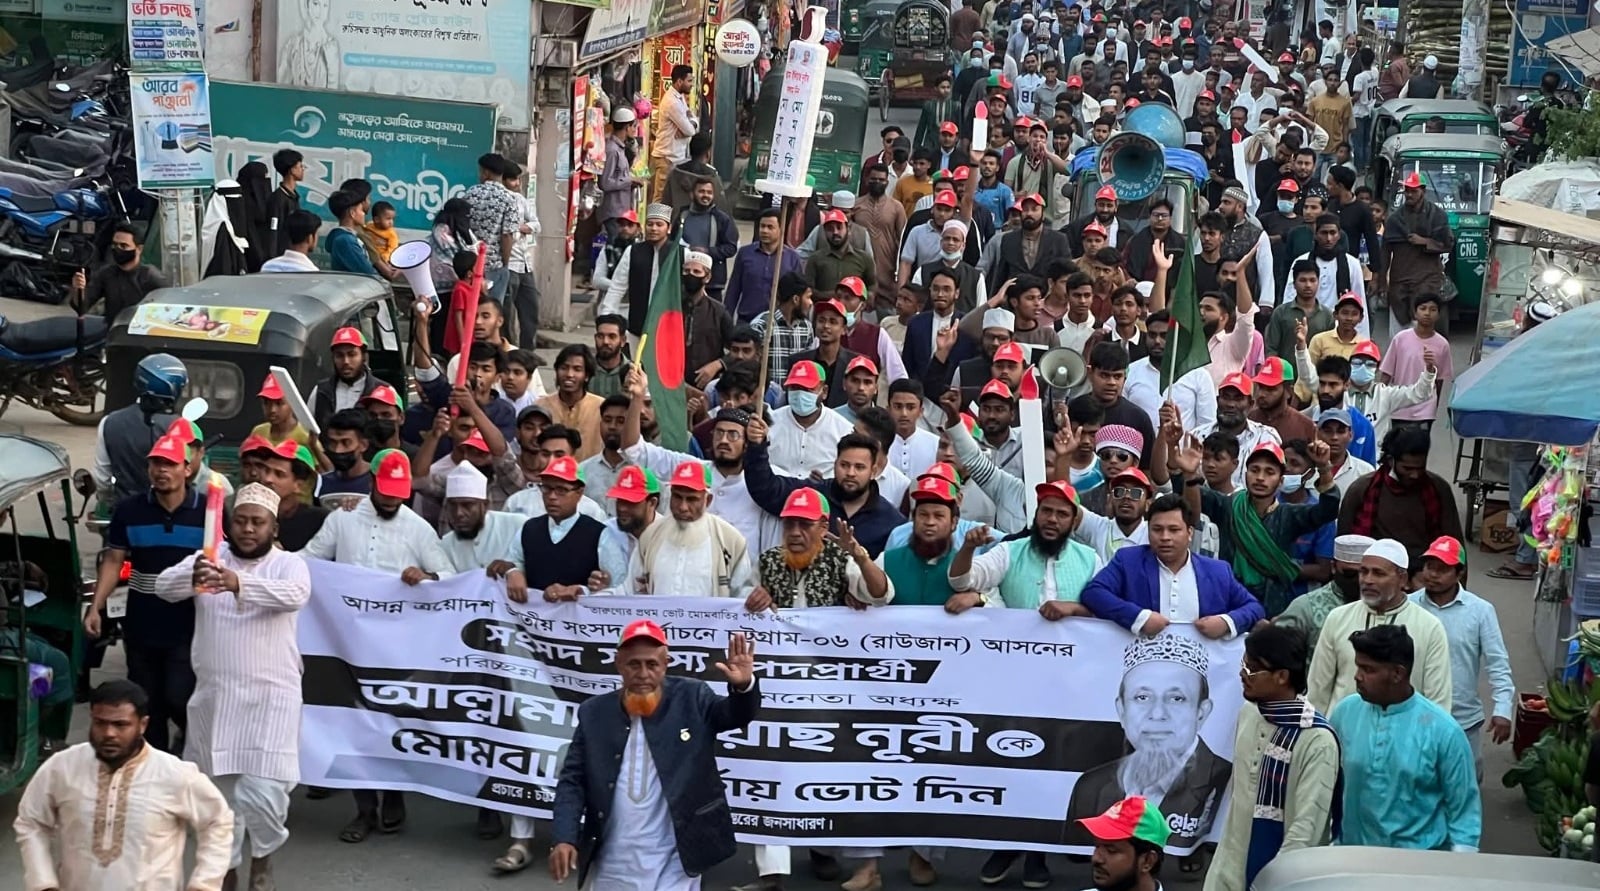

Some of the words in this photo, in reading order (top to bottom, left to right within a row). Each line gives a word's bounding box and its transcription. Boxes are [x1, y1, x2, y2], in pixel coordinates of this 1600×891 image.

[160, 3, 192, 18] চলছে
[142, 77, 178, 95] আরব
[373, 130, 394, 142] সেরা
[1460, 242, 1478, 257] CNG
[636, 608, 658, 618] প্রথম
[662, 607, 685, 618] ভোট
[688, 608, 738, 621] মোমবাতির
[342, 595, 405, 613] আসন্ন
[413, 598, 496, 614] ত্রয়োদশ
[861, 632, 971, 656] (রাউজান)
[982, 638, 1076, 658] আসনের
[485, 624, 584, 666] সংসদ
[869, 693, 963, 708] অধ্যক্ষ
[357, 678, 581, 729] আল্লামা
[852, 714, 979, 763] নূরী
[996, 737, 1036, 752] কে
[491, 783, 524, 799] প্রচারে
[794, 775, 903, 802] ভোট
[914, 775, 1007, 806] দিন
